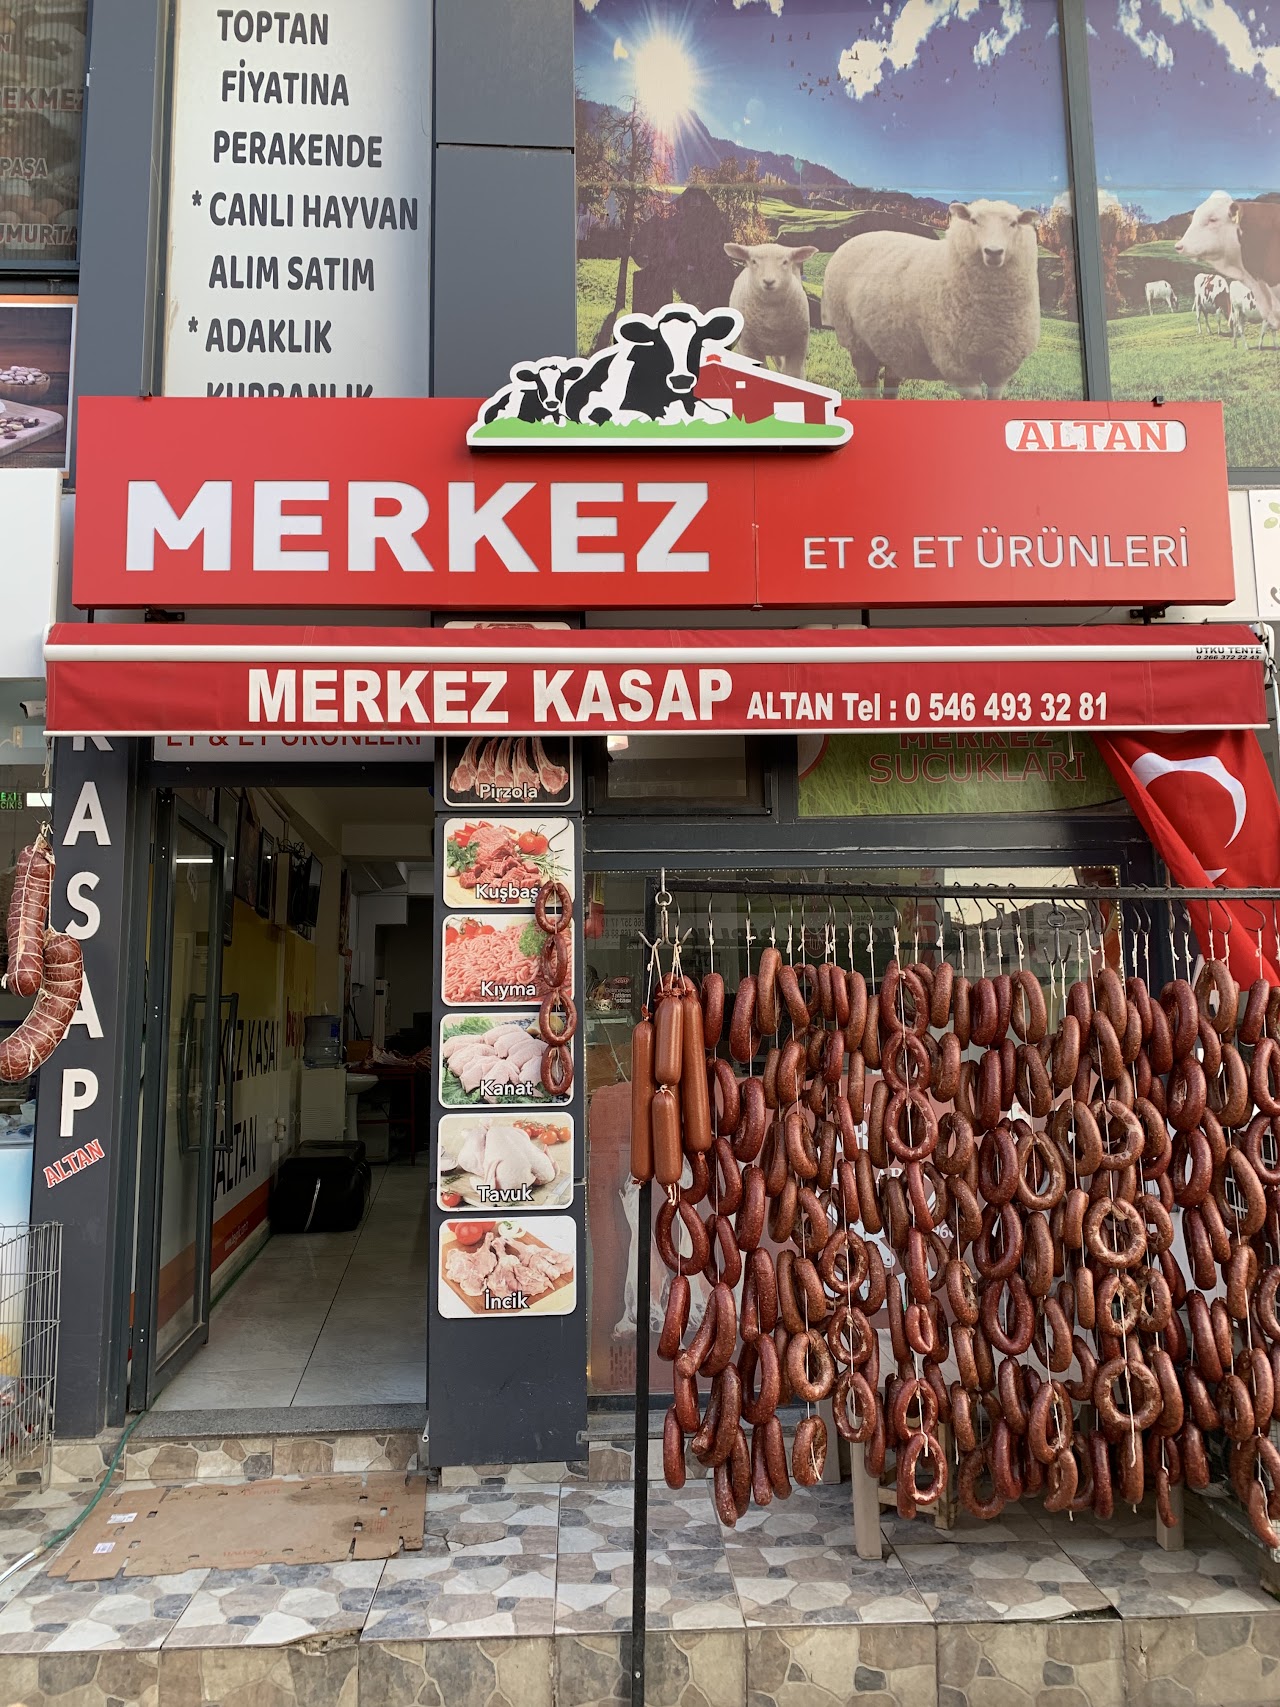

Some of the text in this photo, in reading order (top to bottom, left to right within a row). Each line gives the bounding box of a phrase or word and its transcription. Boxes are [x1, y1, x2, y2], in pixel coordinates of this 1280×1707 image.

[217, 9, 329, 45] TOPTAN
[221, 59, 350, 106] FİYATINA
[213, 130, 383, 168] PERAKENDE
[209, 192, 418, 231] CANLI HAYVAN
[208, 255, 375, 292] ALIM SATIM
[205, 318, 332, 354] ADAKLIK
[1015, 421, 1168, 451] ALTAN
[126, 480, 711, 573] MERKEZ
[804, 527, 1190, 570] ET & ET ÜRÜNLERİ
[1196, 646, 1262, 654] UTKU TENTE
[248, 668, 509, 725] MERKEZ
[532, 668, 734, 724] KASAP
[746, 691, 833, 721] ALTAN
[843, 692, 882, 722] Tel
[905, 692, 920, 721] 0
[928, 693, 976, 721] 546
[984, 693, 1033, 721] 493
[1040, 693, 1071, 721] 32
[1078, 692, 1108, 721] 81
[868, 751, 1087, 784] SUCUKLARI
[479, 782, 538, 800] Pirzola
[475, 882, 543, 904] Kuşbaş
[481, 981, 536, 1000] Kıyma
[480, 1079, 534, 1096] Kanat
[43, 1138, 105, 1188] ALTAN
[477, 1185, 534, 1202] Tavuk
[485, 1289, 529, 1310] İncik
